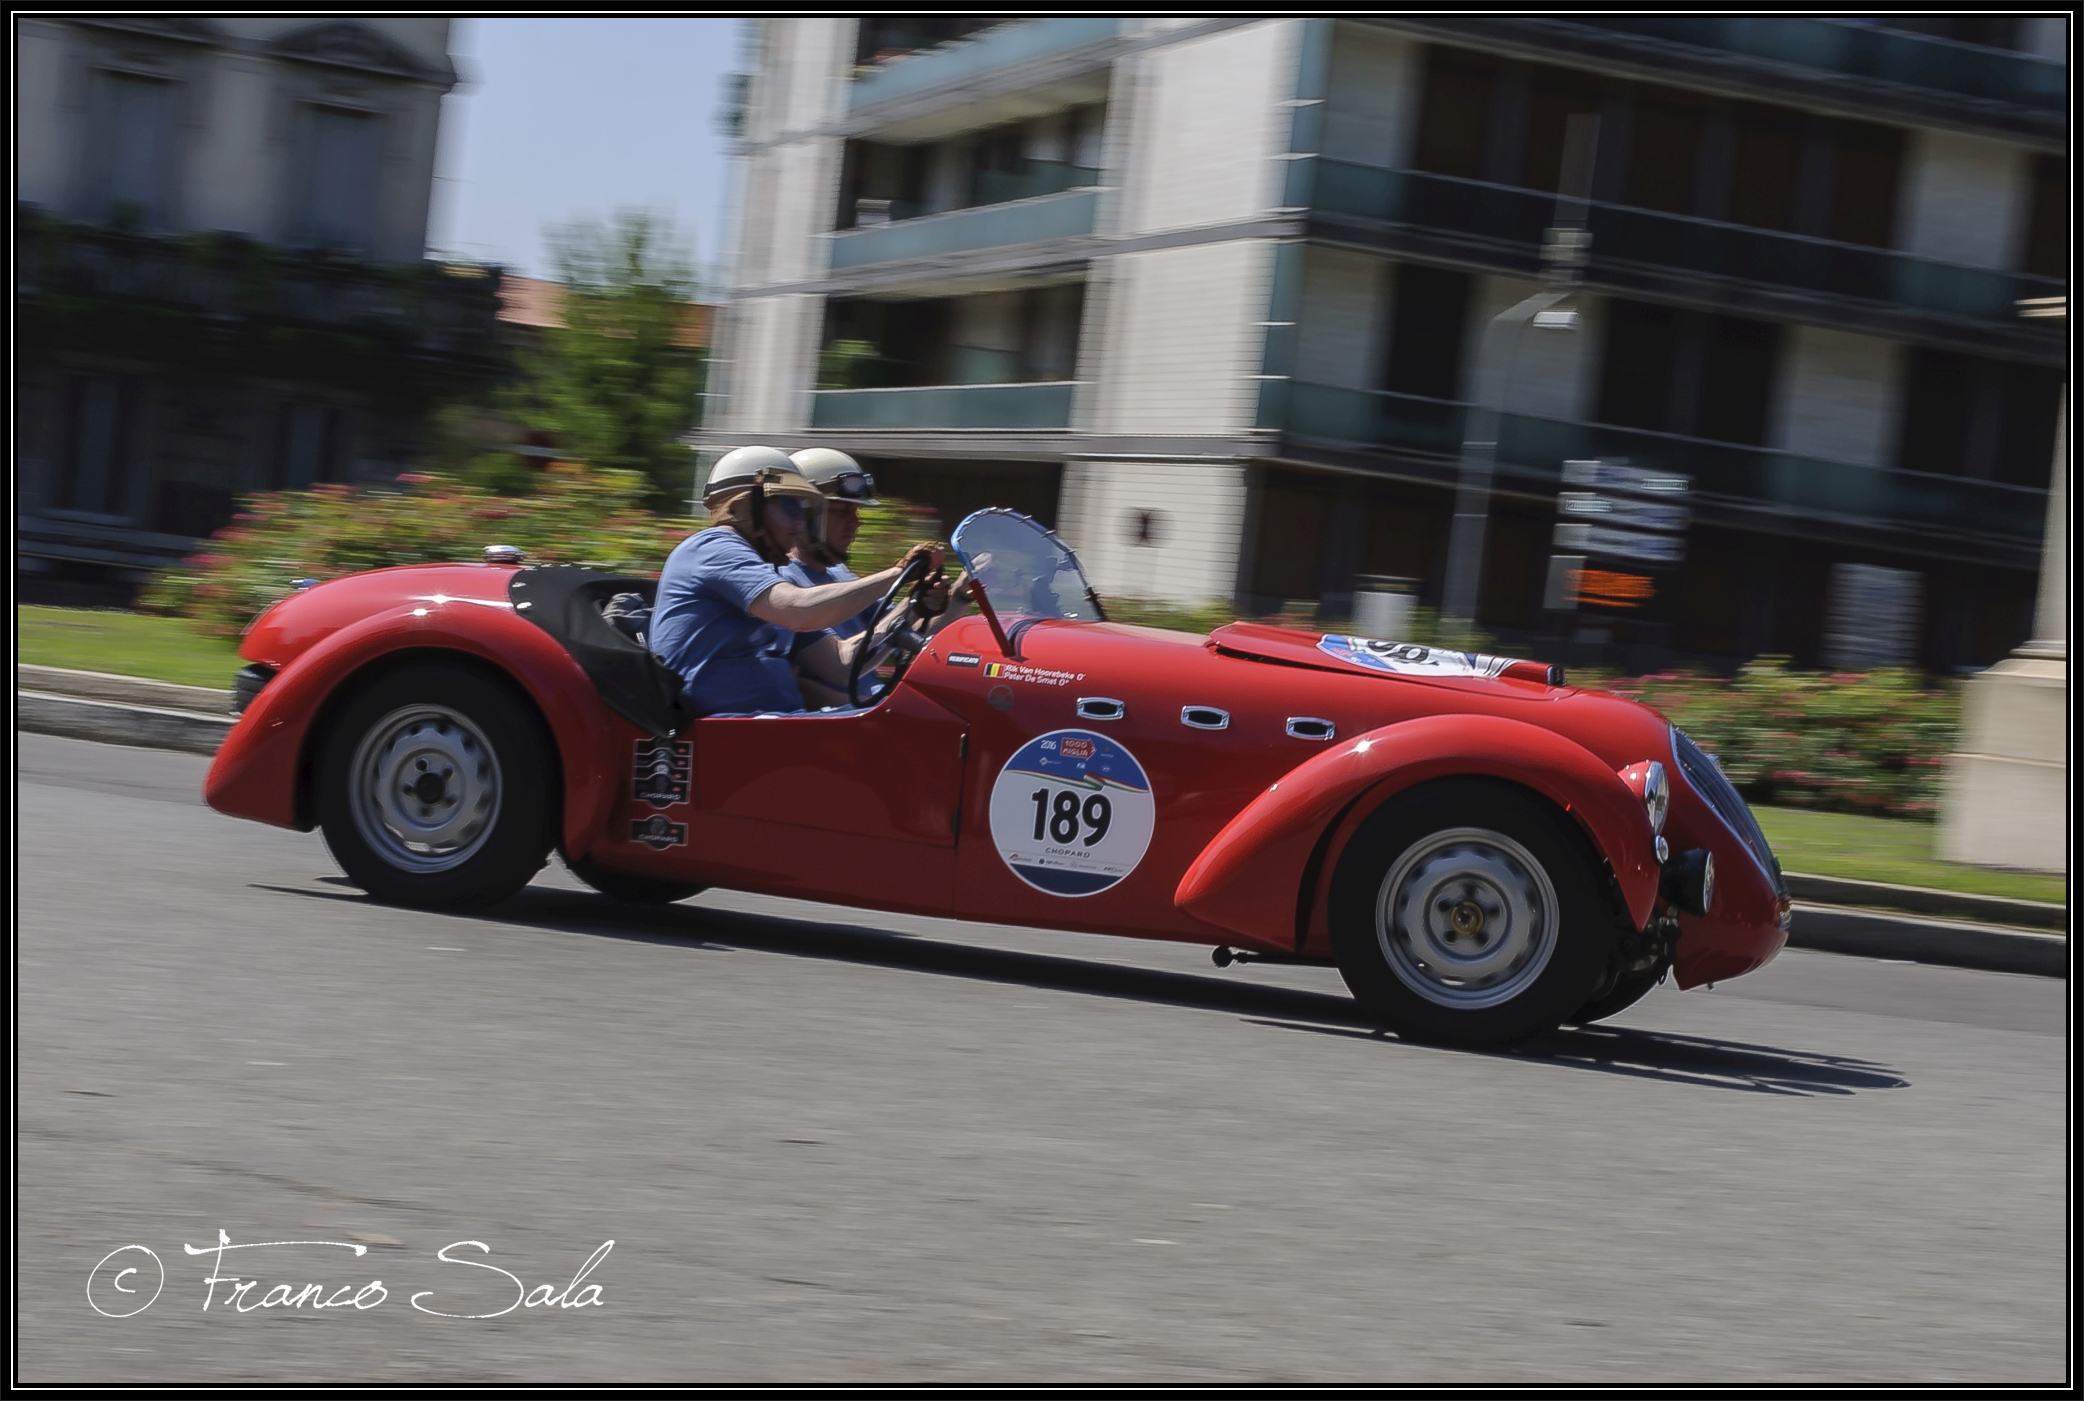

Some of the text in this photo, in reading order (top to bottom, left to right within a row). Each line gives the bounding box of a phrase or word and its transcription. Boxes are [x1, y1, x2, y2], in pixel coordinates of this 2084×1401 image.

[1020, 665, 1034, 675] Van
[1003, 671, 1025, 681] Peter
[1025, 673, 1036, 683] De
[1036, 675, 1057, 686] Smet
[1064, 740, 1088, 749] 1000
[1031, 787, 1112, 847] 189
[1044, 847, 1091, 859] CHOPARD
